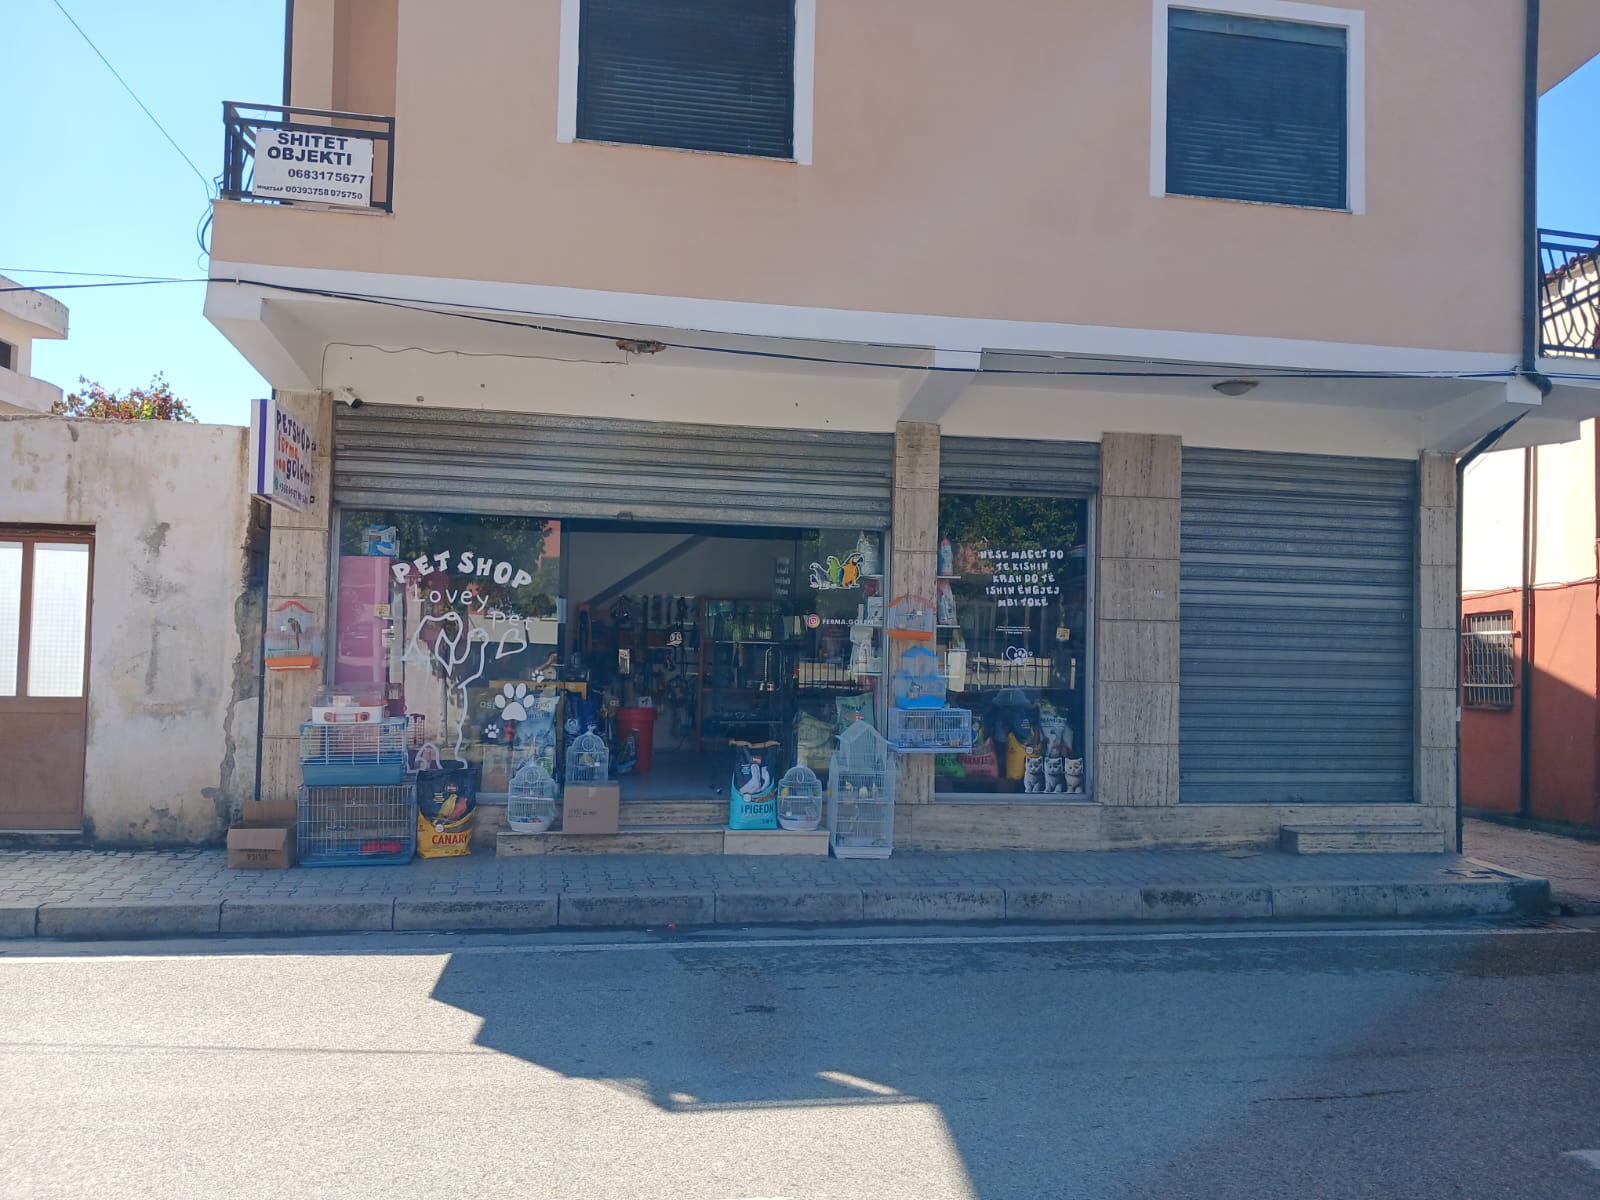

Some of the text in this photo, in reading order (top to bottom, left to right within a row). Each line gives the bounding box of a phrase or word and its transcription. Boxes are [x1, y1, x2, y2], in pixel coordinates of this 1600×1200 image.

[277, 132, 349, 151] SHITET
[267, 146, 352, 166] OBJEKTI
[288, 168, 366, 185] 0683175677
[276, 409, 311, 453] PETSHOP
[1049, 550, 1064, 560] DO
[391, 550, 532, 589] PET SHOP
[1012, 562, 1049, 571] KISHIN
[992, 574, 1022, 583] KRAH
[1024, 573, 1039, 584] DO
[985, 586, 1015, 595] ISHIN
[414, 583, 489, 613] Lovey
[997, 598, 1018, 608] MBI
[431, 833, 468, 845] CANARY
